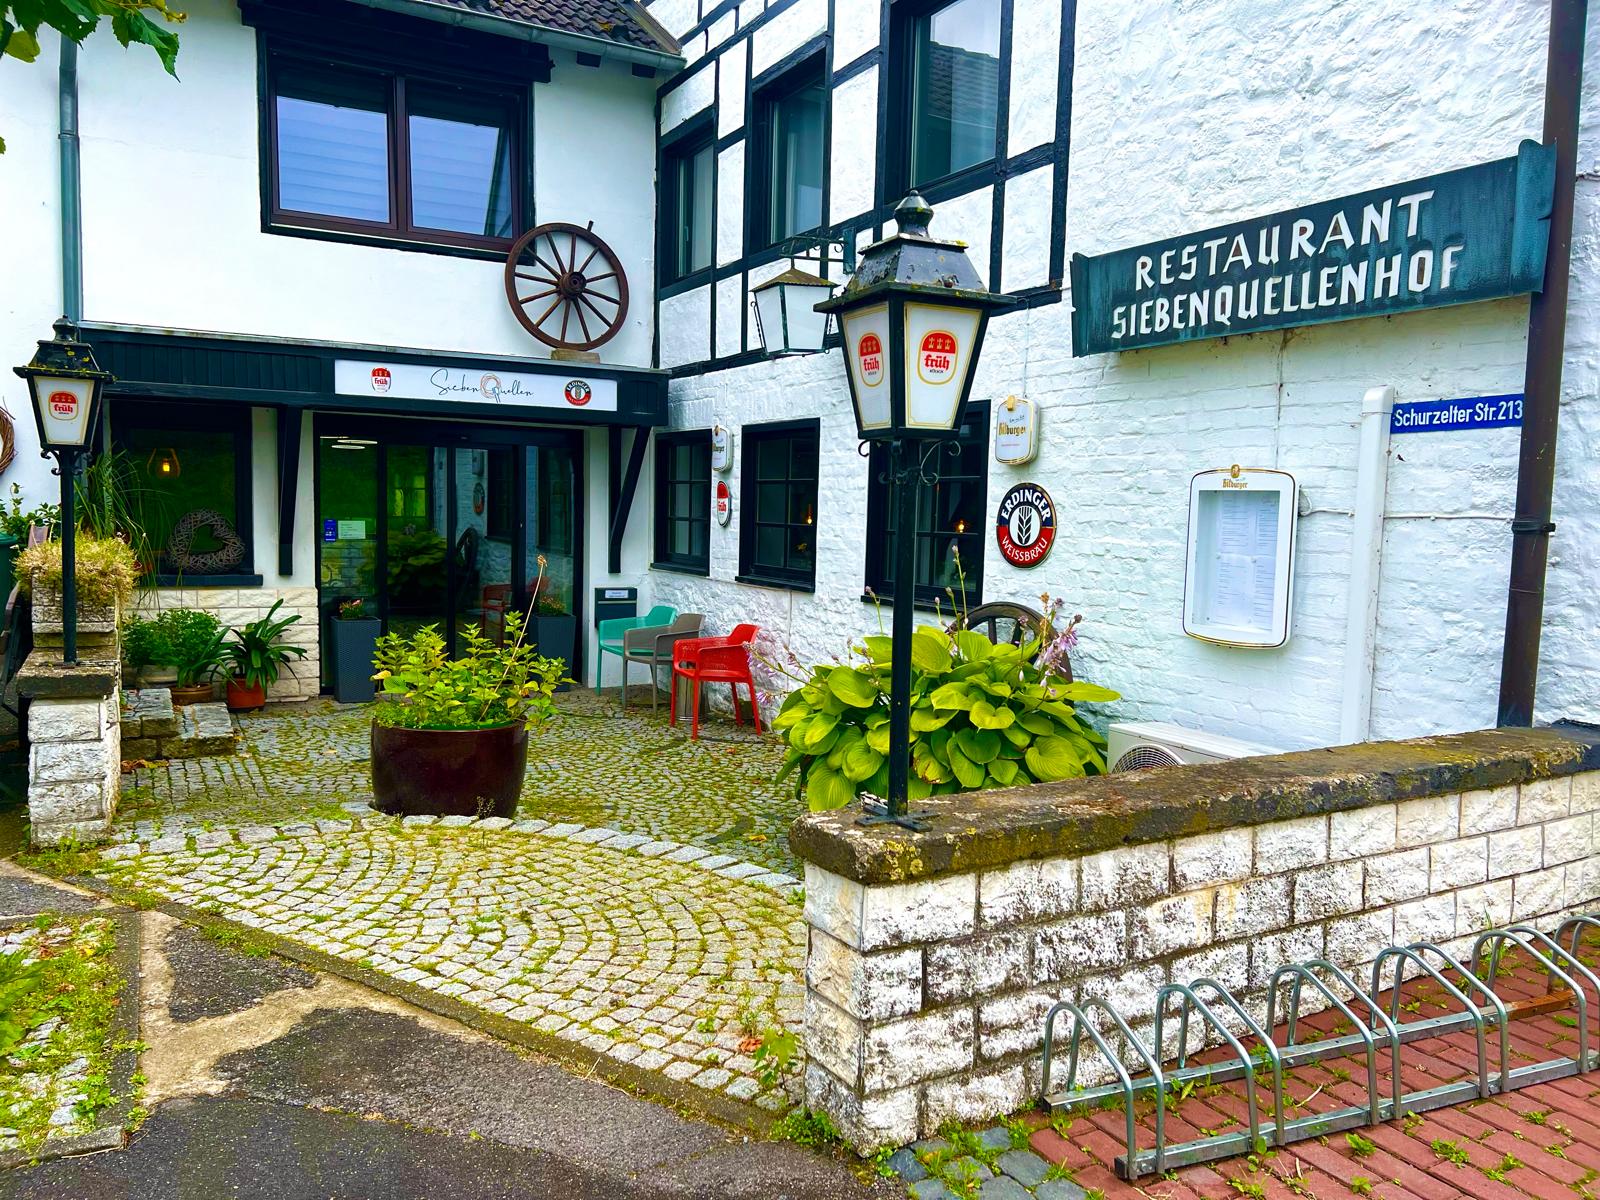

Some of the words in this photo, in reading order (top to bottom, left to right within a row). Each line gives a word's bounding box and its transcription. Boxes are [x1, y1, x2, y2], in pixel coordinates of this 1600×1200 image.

[1135, 190, 1435, 292] RESTAURANT
[1111, 244, 1464, 339] SIEBENQUELLENHOF
[863, 356, 880, 373] früh
[924, 354, 950, 372] früh
[53, 404, 73, 413] früh
[1394, 408, 1473, 427] Schurzelter
[1001, 489, 1051, 522] ERDINGER
[1002, 536, 1048, 561] WEISSBRÄU
